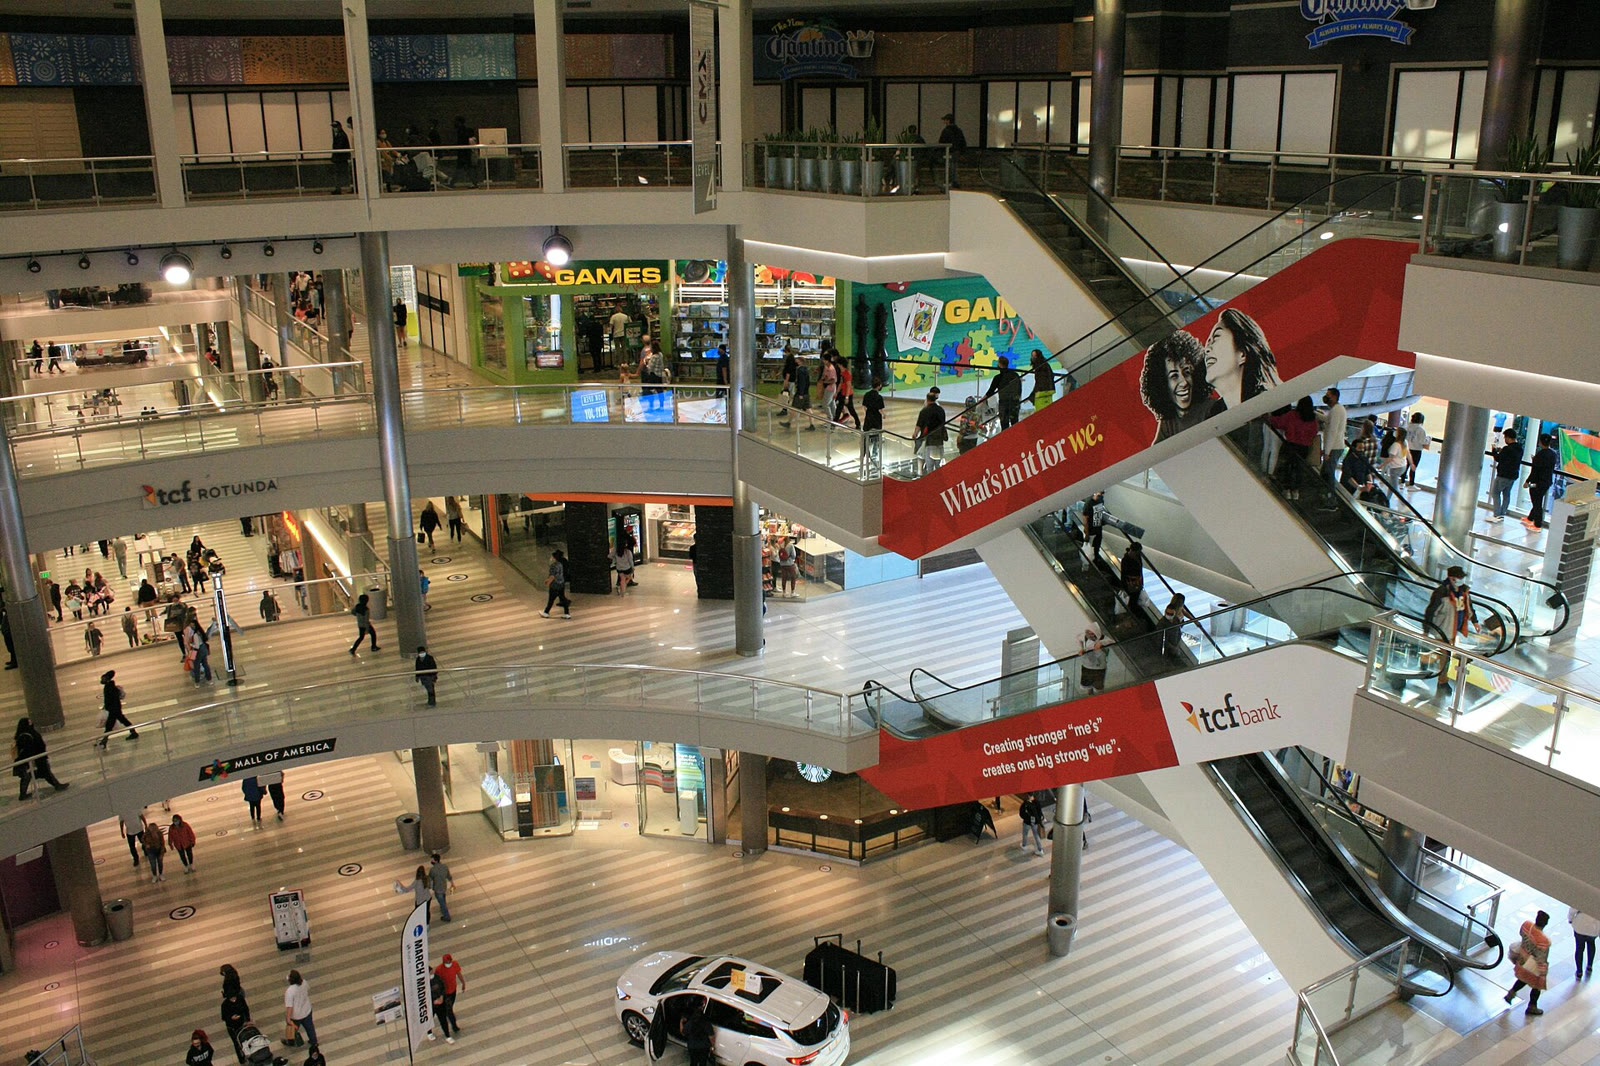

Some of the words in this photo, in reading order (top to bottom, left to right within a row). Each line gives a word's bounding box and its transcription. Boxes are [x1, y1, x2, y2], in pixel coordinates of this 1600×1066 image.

[1319, 26, 1340, 37] ALWAYS
[1340, 23, 1357, 32] FRESH
[698, 49, 707, 125] CMX
[695, 163, 710, 178] LEVEL
[706, 164, 716, 209] 4
[555, 267, 662, 286] GAMES
[999, 302, 1022, 346] by
[1000, 463, 1024, 490] in
[1020, 451, 1039, 480] it
[1036, 438, 1067, 472] for
[1067, 423, 1104, 455] we.
[157, 480, 192, 506] tcf
[198, 480, 278, 500] ROTUNDA
[1199, 693, 1240, 733] tcf
[1236, 698, 1281, 726] bank
[234, 757, 262, 769] MALL
[264, 751, 280, 761] OF
[282, 742, 330, 758] AMERICA
[983, 737, 1025, 756] Creating
[1025, 728, 1067, 747] stronger
[982, 762, 1016, 778] creates
[1017, 758, 1036, 771] one
[1035, 752, 1054, 769] big
[1054, 746, 1089, 763] strong
[414, 938, 425, 977] MARCH
[416, 977, 428, 1025] MADNESS
